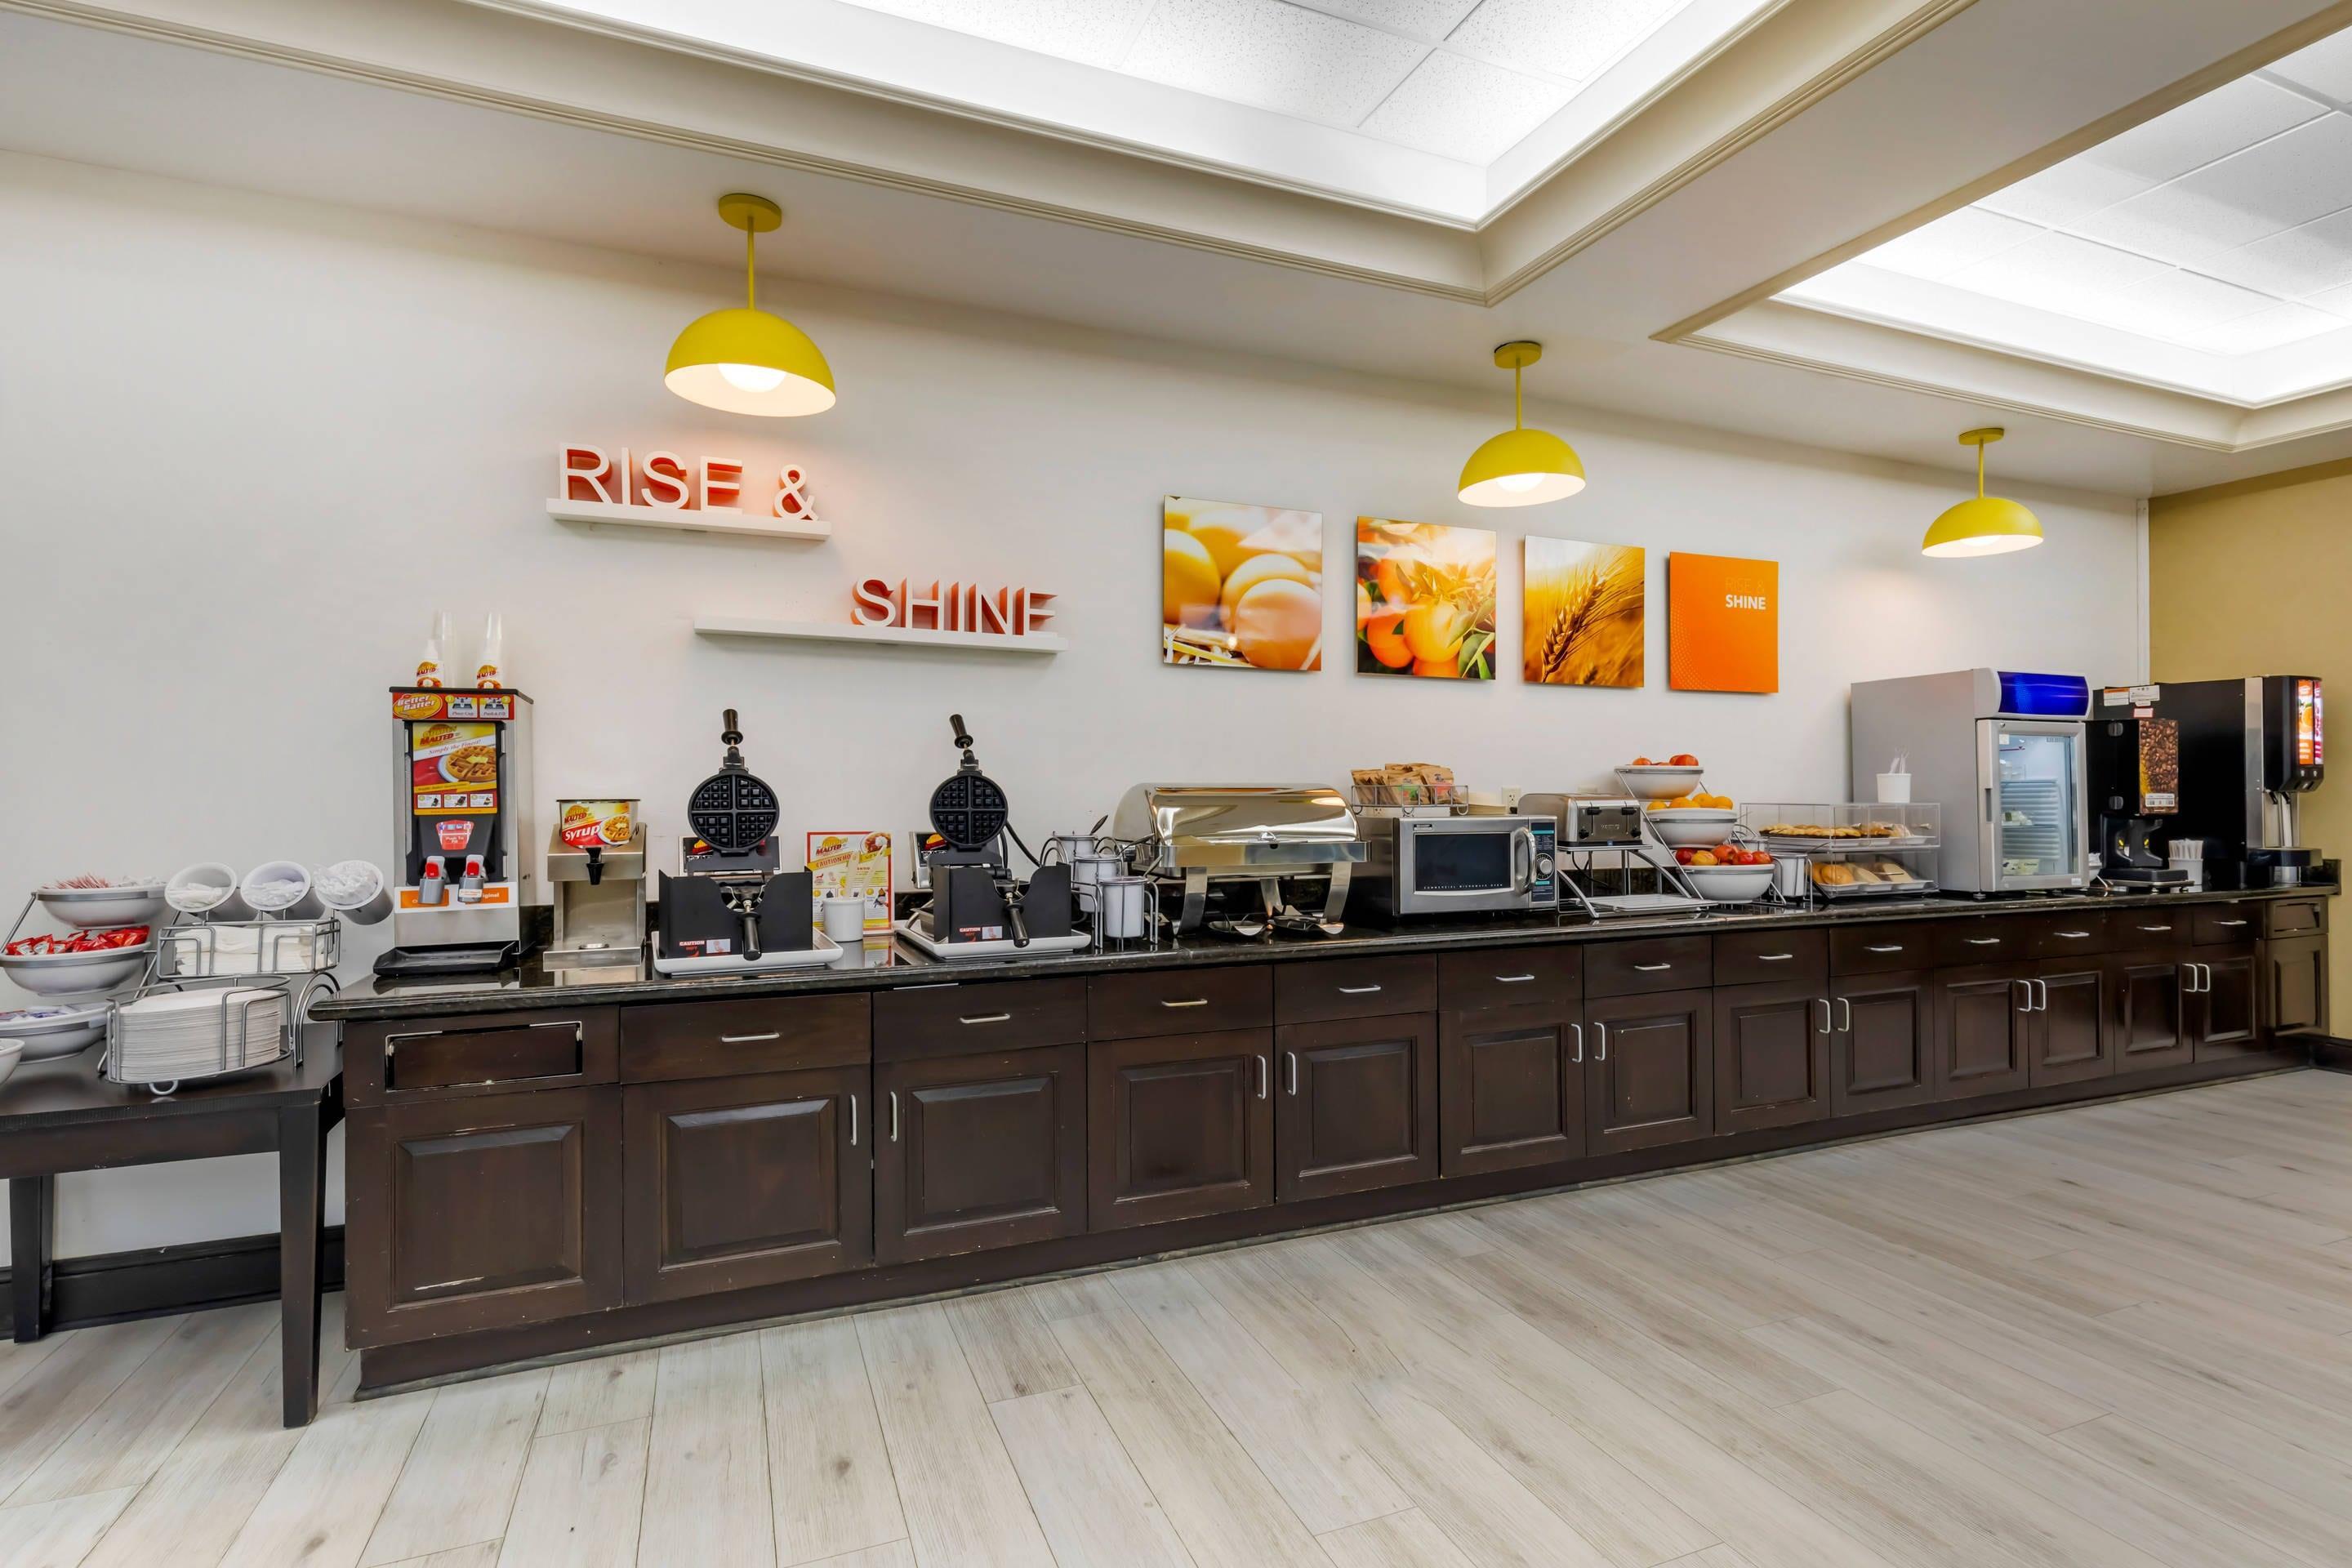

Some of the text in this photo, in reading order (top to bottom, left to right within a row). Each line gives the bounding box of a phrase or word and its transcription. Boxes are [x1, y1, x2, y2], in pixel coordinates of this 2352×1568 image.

[559, 442, 819, 522] RISE &
[850, 575, 1058, 639] SHINE
[1725, 594, 1766, 610] SHINE
[398, 695, 430, 706] Better
[403, 701, 435, 710] Batter
[420, 733, 454, 745] MALTED
[564, 825, 600, 842] Syrup
[816, 844, 843, 855] MALTED
[816, 855, 841, 868] CAUTION
